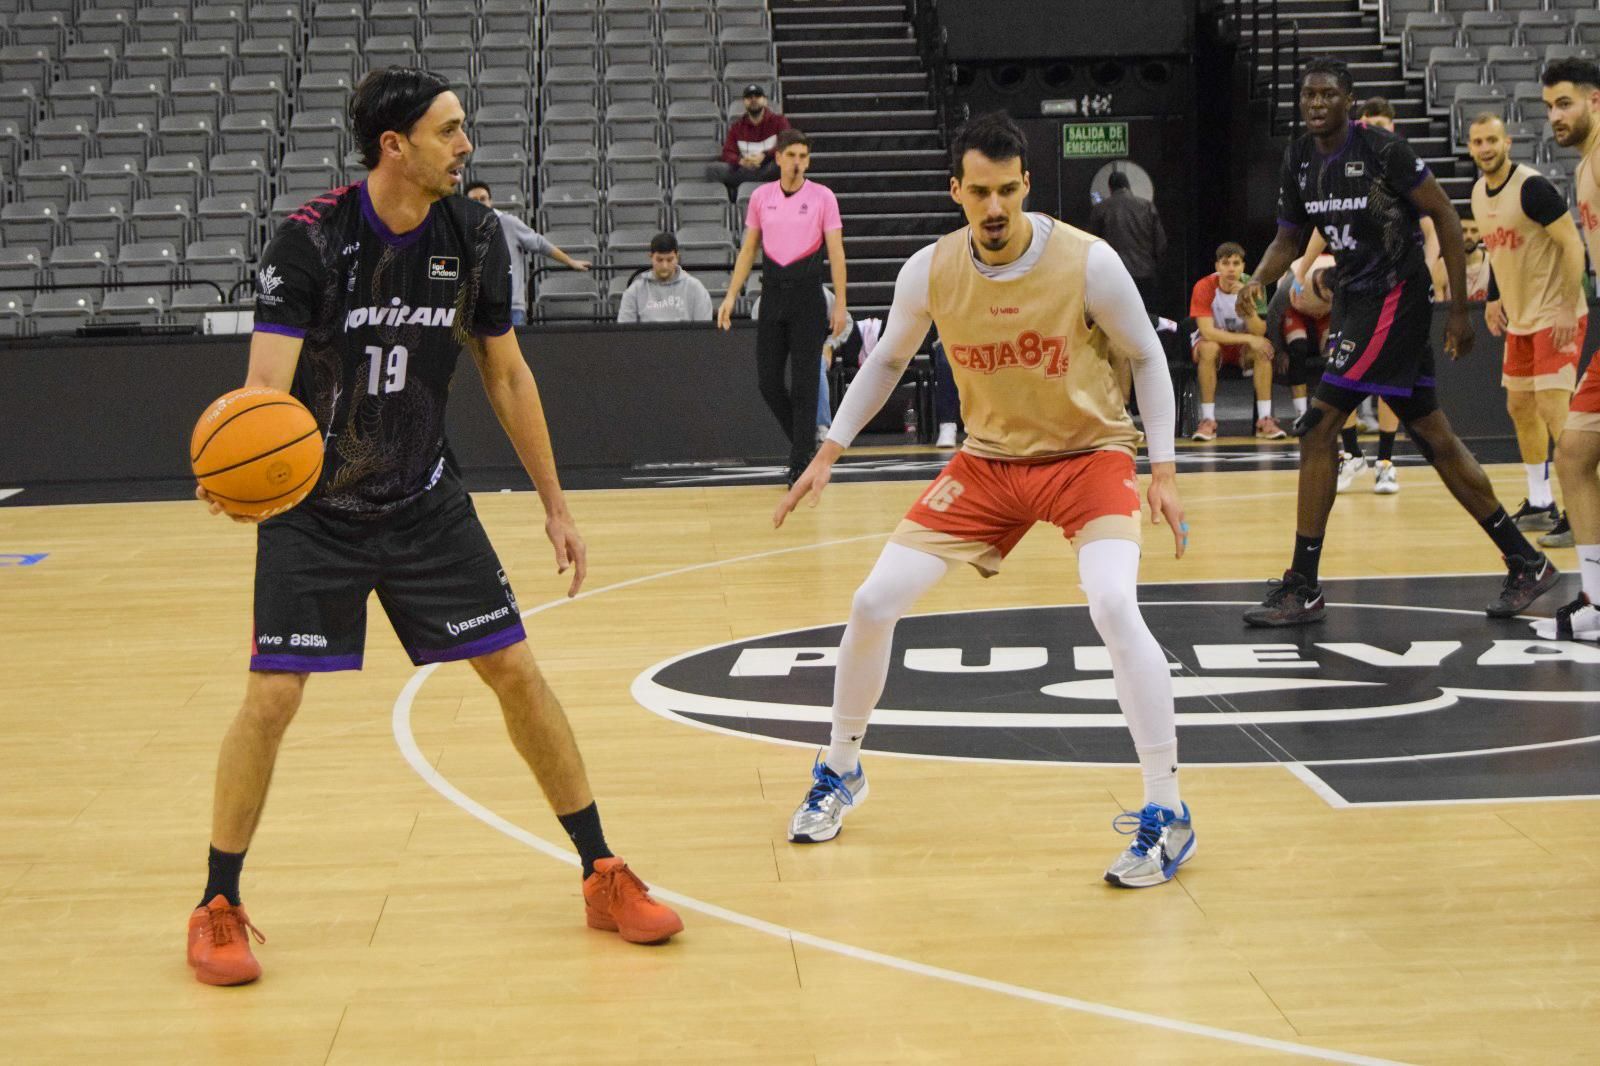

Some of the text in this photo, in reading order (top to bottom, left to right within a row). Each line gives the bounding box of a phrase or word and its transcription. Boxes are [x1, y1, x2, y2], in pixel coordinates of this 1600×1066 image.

[1068, 125, 1123, 140] SALIDA DE
[1065, 140, 1126, 154] EMERGENCIA
[1324, 224, 1357, 250] 34
[365, 344, 409, 396] 19
[921, 474, 965, 512] 16
[458, 606, 510, 631] BERNER
[258, 633, 283, 646] vive
